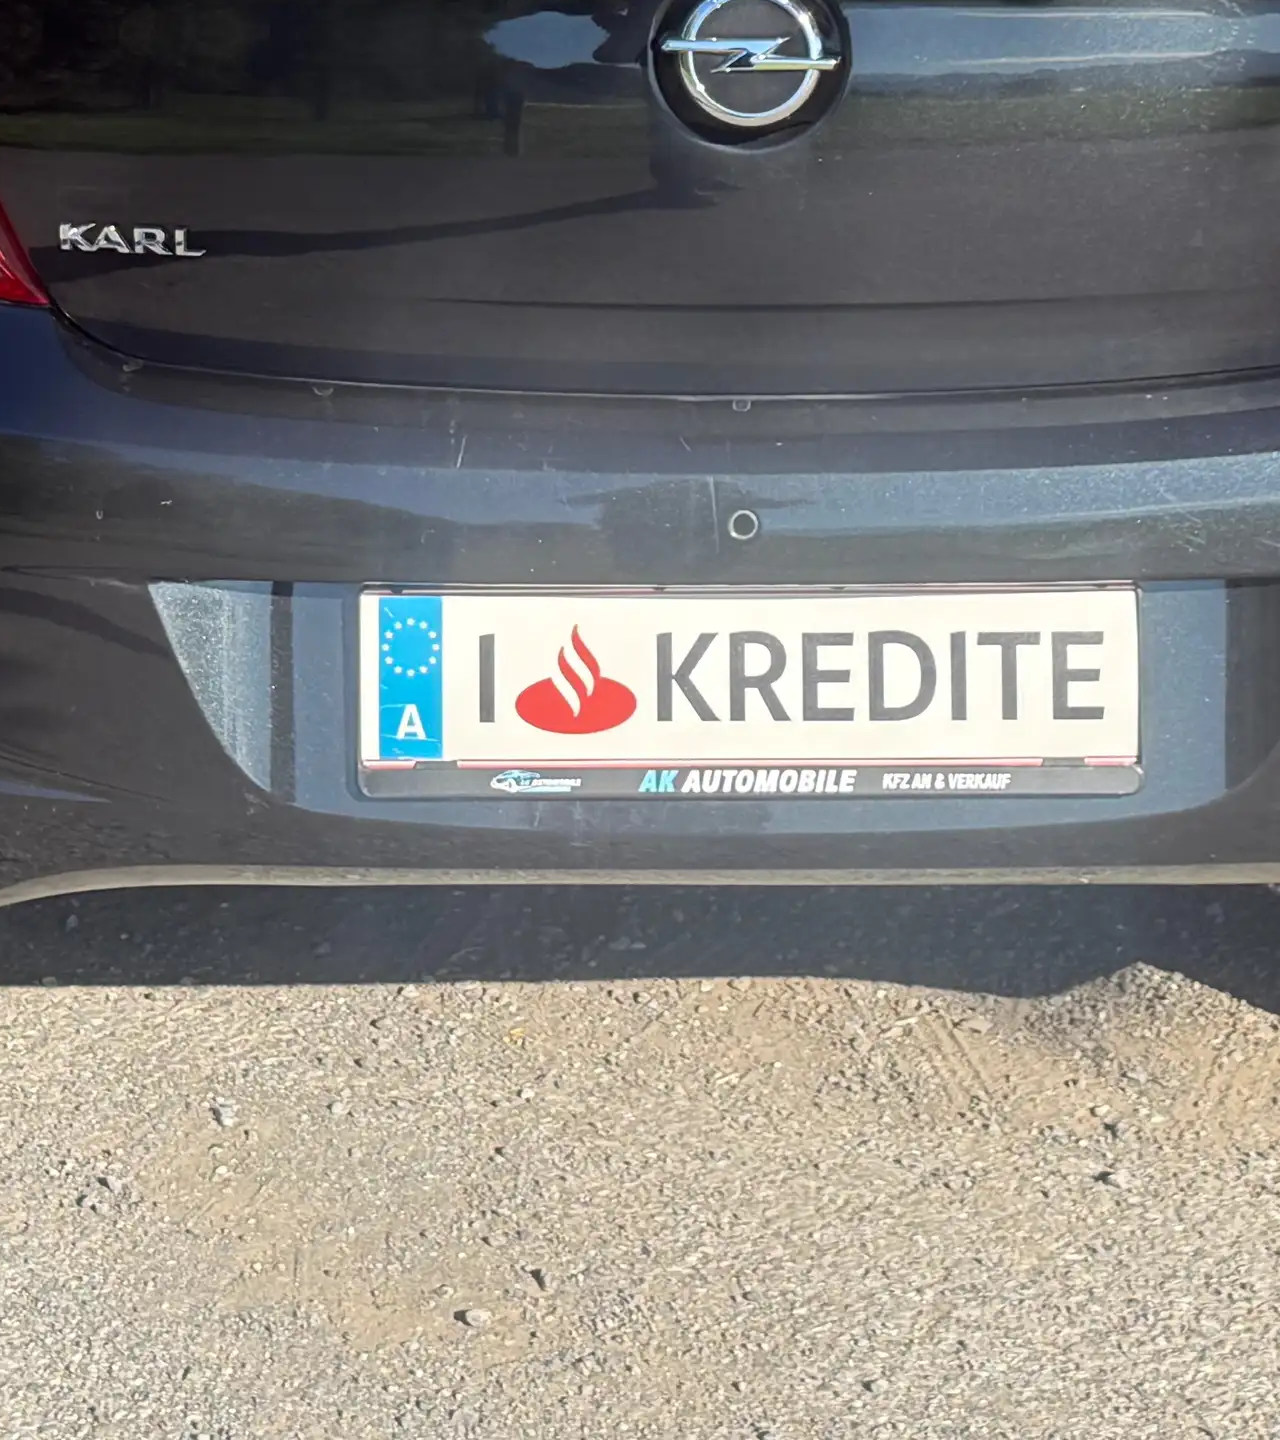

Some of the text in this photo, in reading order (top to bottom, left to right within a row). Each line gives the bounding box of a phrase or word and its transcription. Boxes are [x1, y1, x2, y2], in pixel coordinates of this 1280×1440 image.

[60, 223, 207, 256] KARL
[479, 630, 1107, 723] I KREDITE
[396, 703, 426, 740] A
[638, 769, 858, 793] AK AUTOMOBILE
[883, 773, 911, 790] KFZ
[934, 773, 945, 790] &
[947, 773, 1012, 790] VERKAUF
